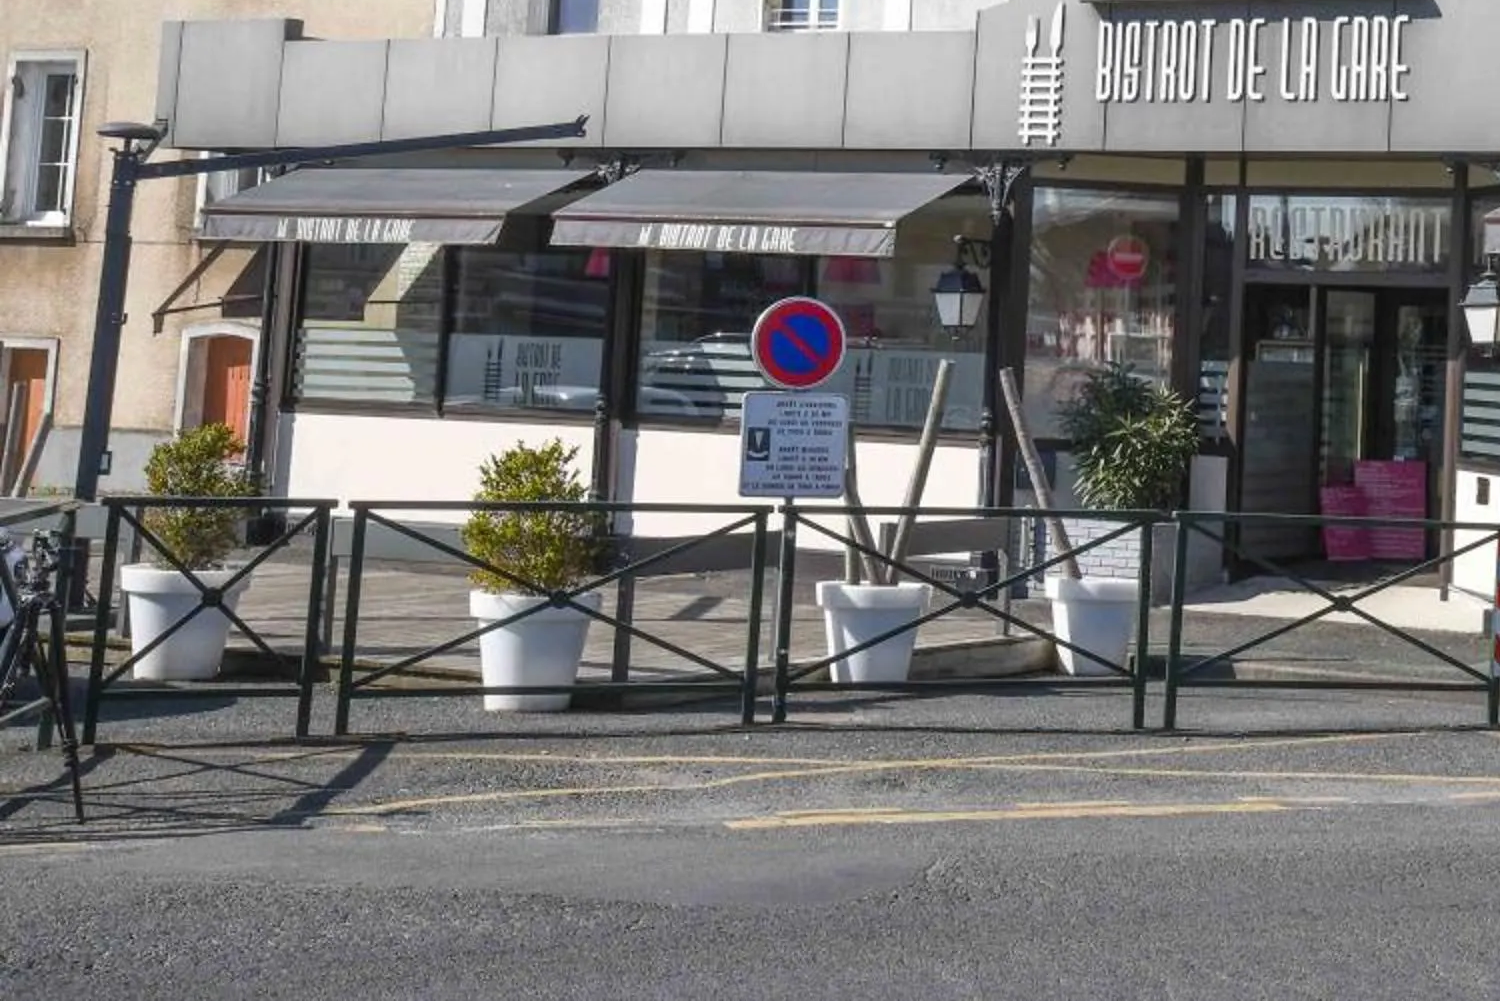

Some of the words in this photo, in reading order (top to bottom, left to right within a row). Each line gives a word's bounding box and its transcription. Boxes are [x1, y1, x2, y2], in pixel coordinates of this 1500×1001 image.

[1096, 19, 1216, 101] BISTROT
[1227, 18, 1266, 100] DE
[1280, 17, 1317, 100] LA
[1331, 15, 1409, 100] GARE
[659, 223, 713, 248] BISTROT
[716, 226, 736, 249] DE
[739, 226, 758, 250] LA
[761, 227, 796, 252] GARE
